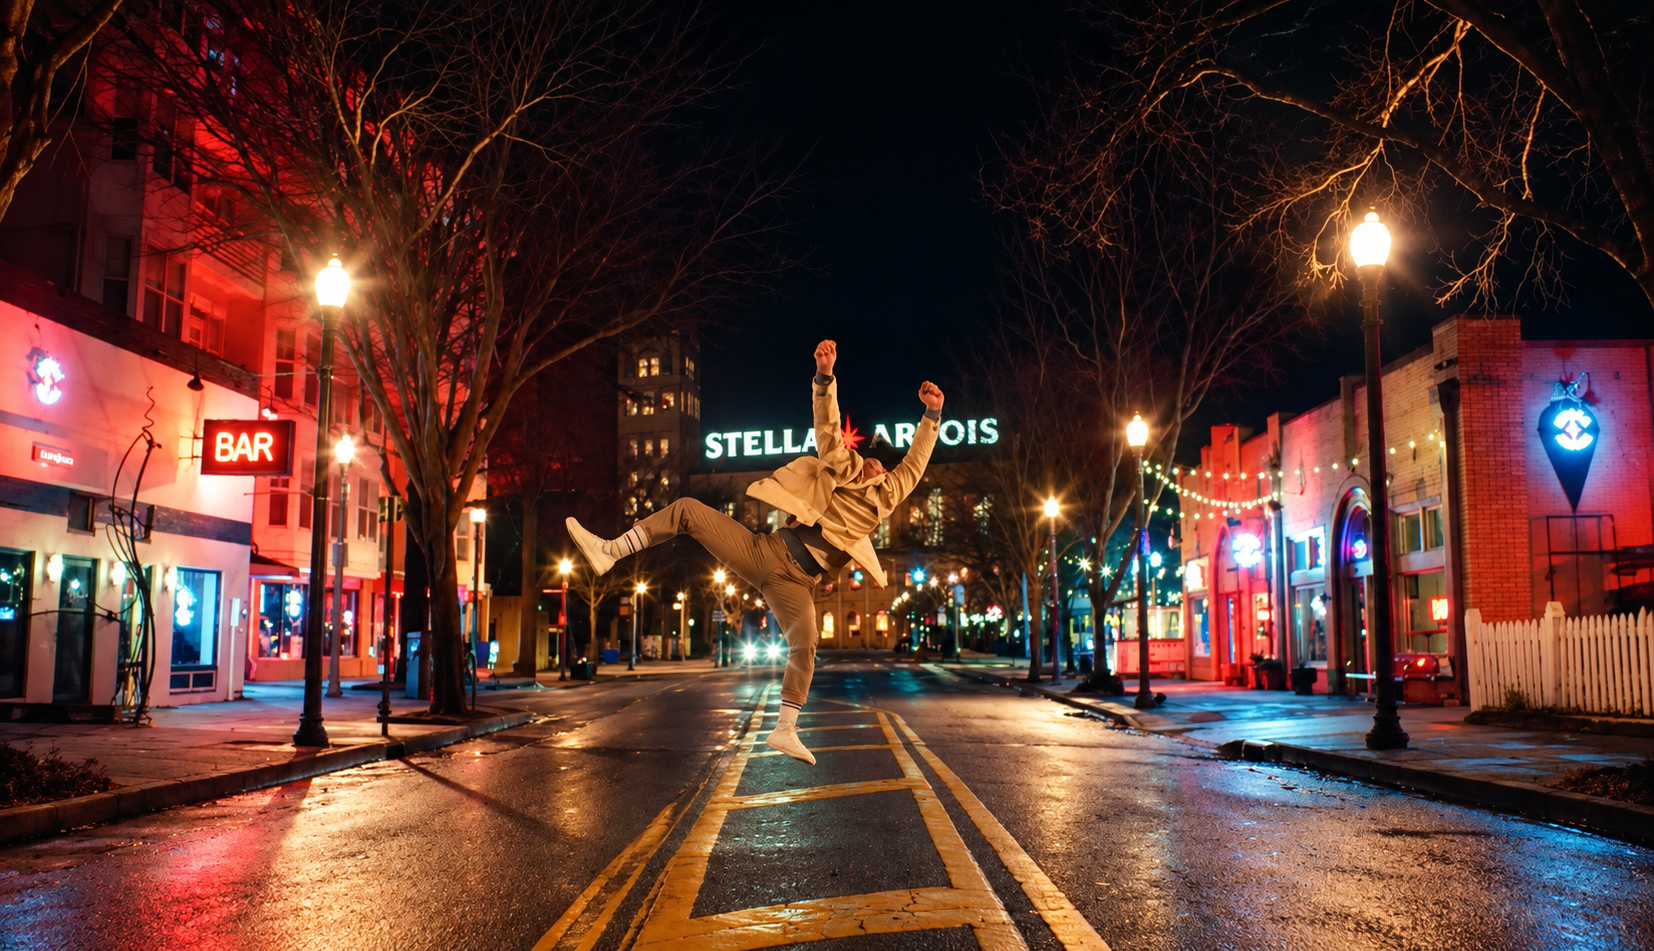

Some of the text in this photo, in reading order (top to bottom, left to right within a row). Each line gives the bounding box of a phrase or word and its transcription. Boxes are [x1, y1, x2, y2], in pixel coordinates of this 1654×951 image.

[214, 431, 274, 462] BAR
[705, 417, 999, 459] STELLA AROIS
